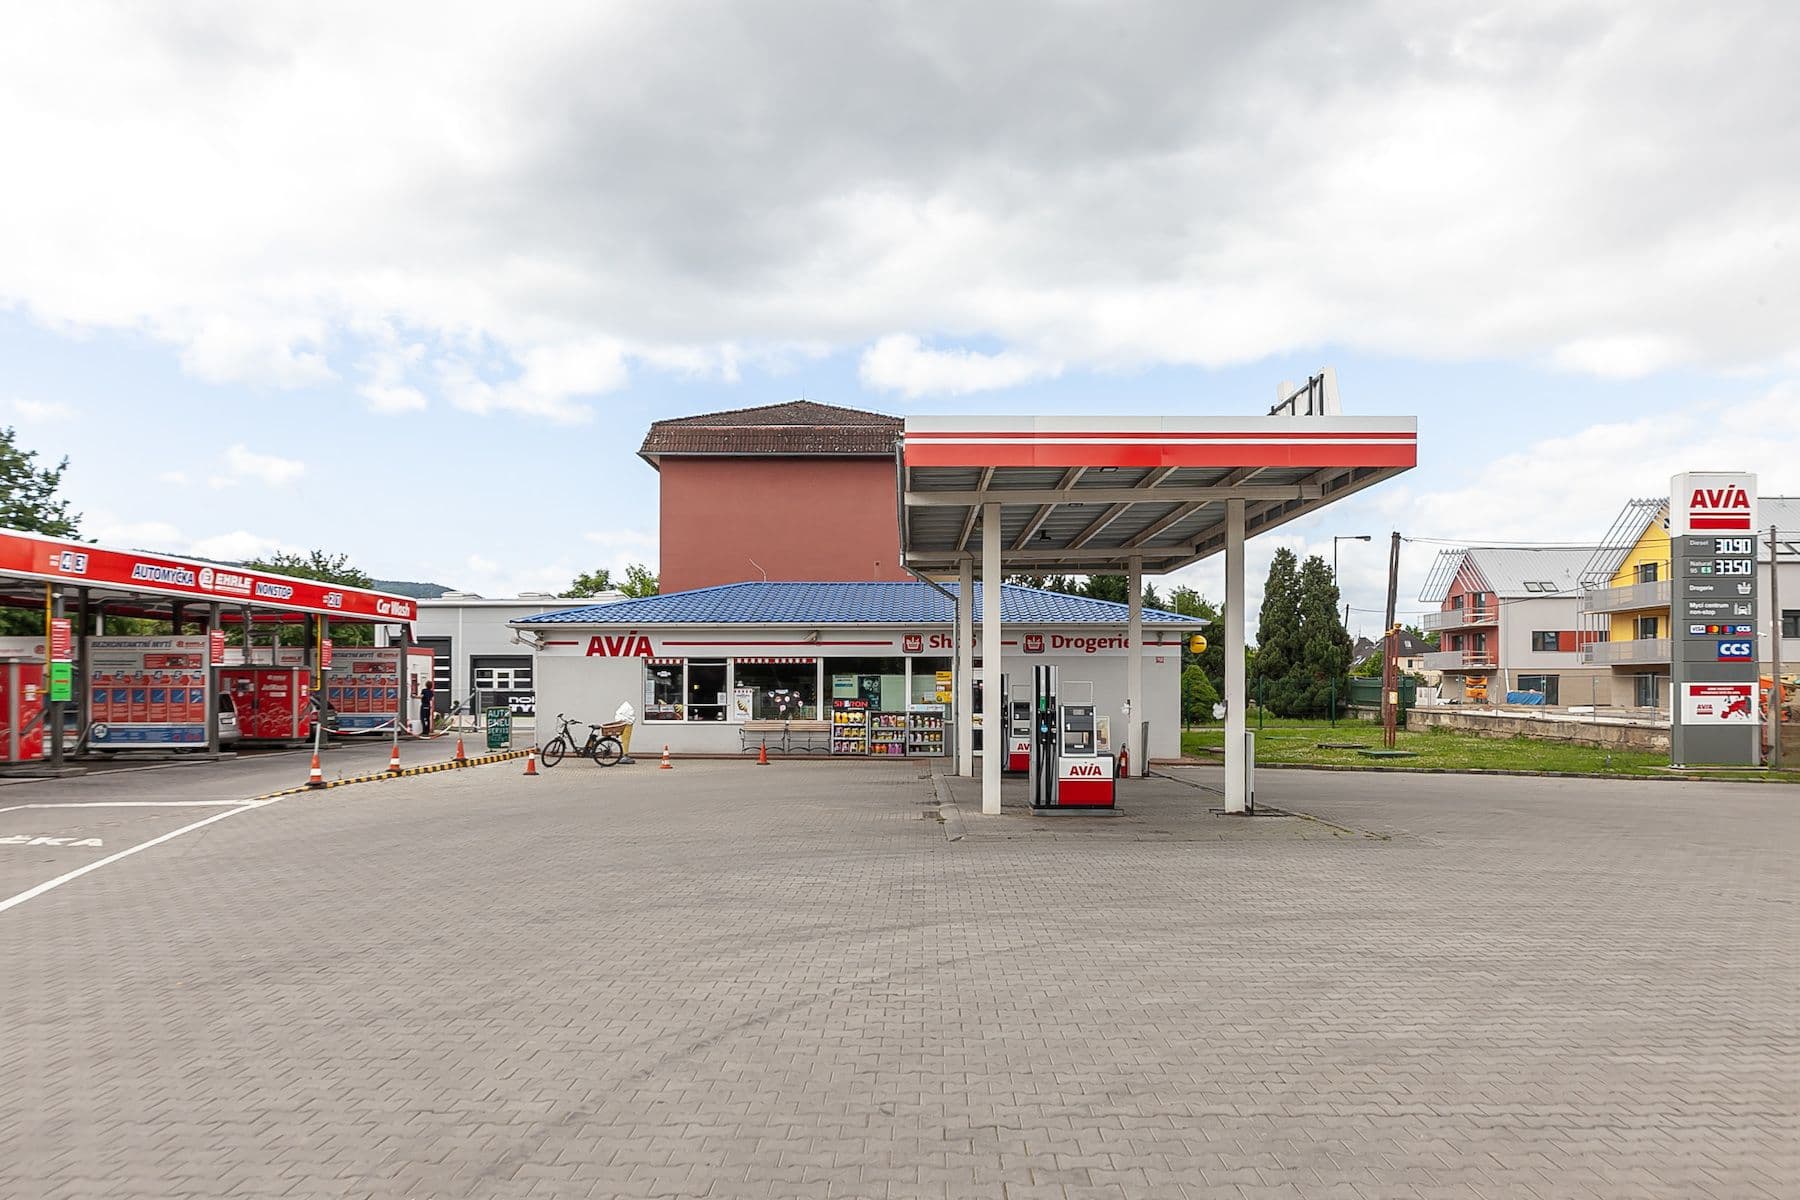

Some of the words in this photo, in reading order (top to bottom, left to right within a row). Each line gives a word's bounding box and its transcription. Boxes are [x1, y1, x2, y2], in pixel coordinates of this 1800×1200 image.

[134, 566, 194, 585] AUTOMYČKA
[216, 574, 253, 587] EHRLE
[256, 583, 291, 598] NONSTOP
[377, 599, 390, 614] Car
[391, 601, 410, 617] Wash
[1720, 643, 1750, 655] CCS
[1017, 743, 1030, 751] AV
